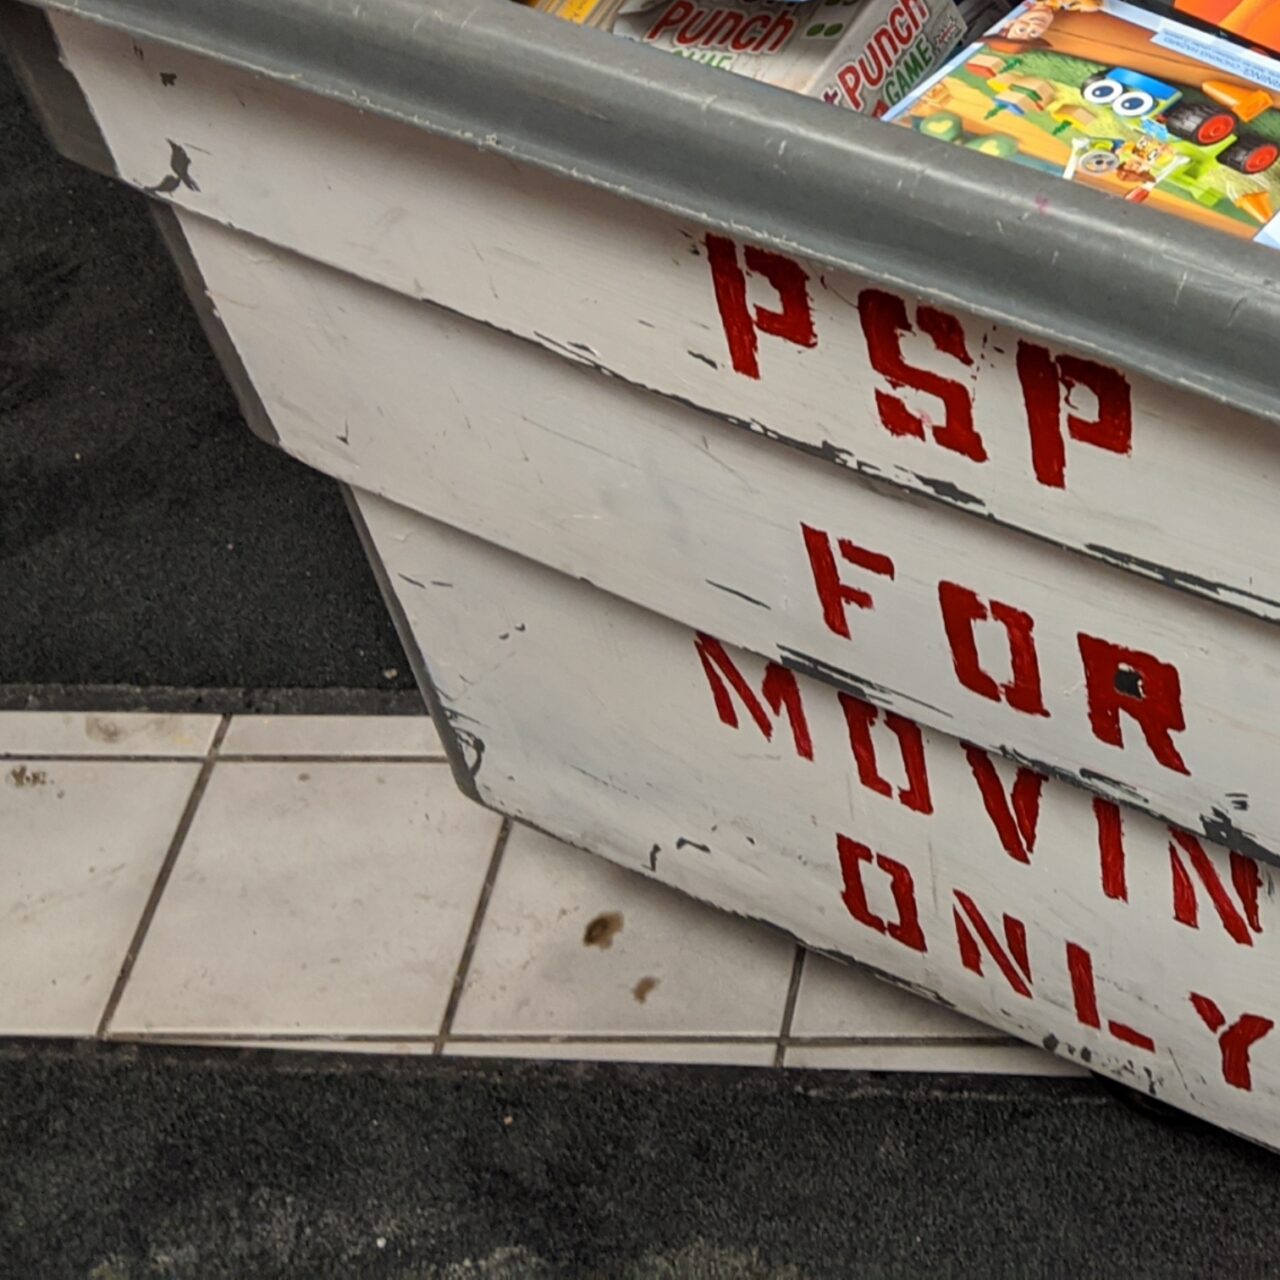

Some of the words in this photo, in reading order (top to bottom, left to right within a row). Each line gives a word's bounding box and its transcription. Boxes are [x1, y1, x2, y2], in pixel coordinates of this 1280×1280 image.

[647, 0, 797, 53] Punch
[885, 34, 934, 107] GAME
[703, 231, 1133, 489] PSP
[800, 522, 1191, 777] FOR
[835, 832, 1275, 1092] ONLY
